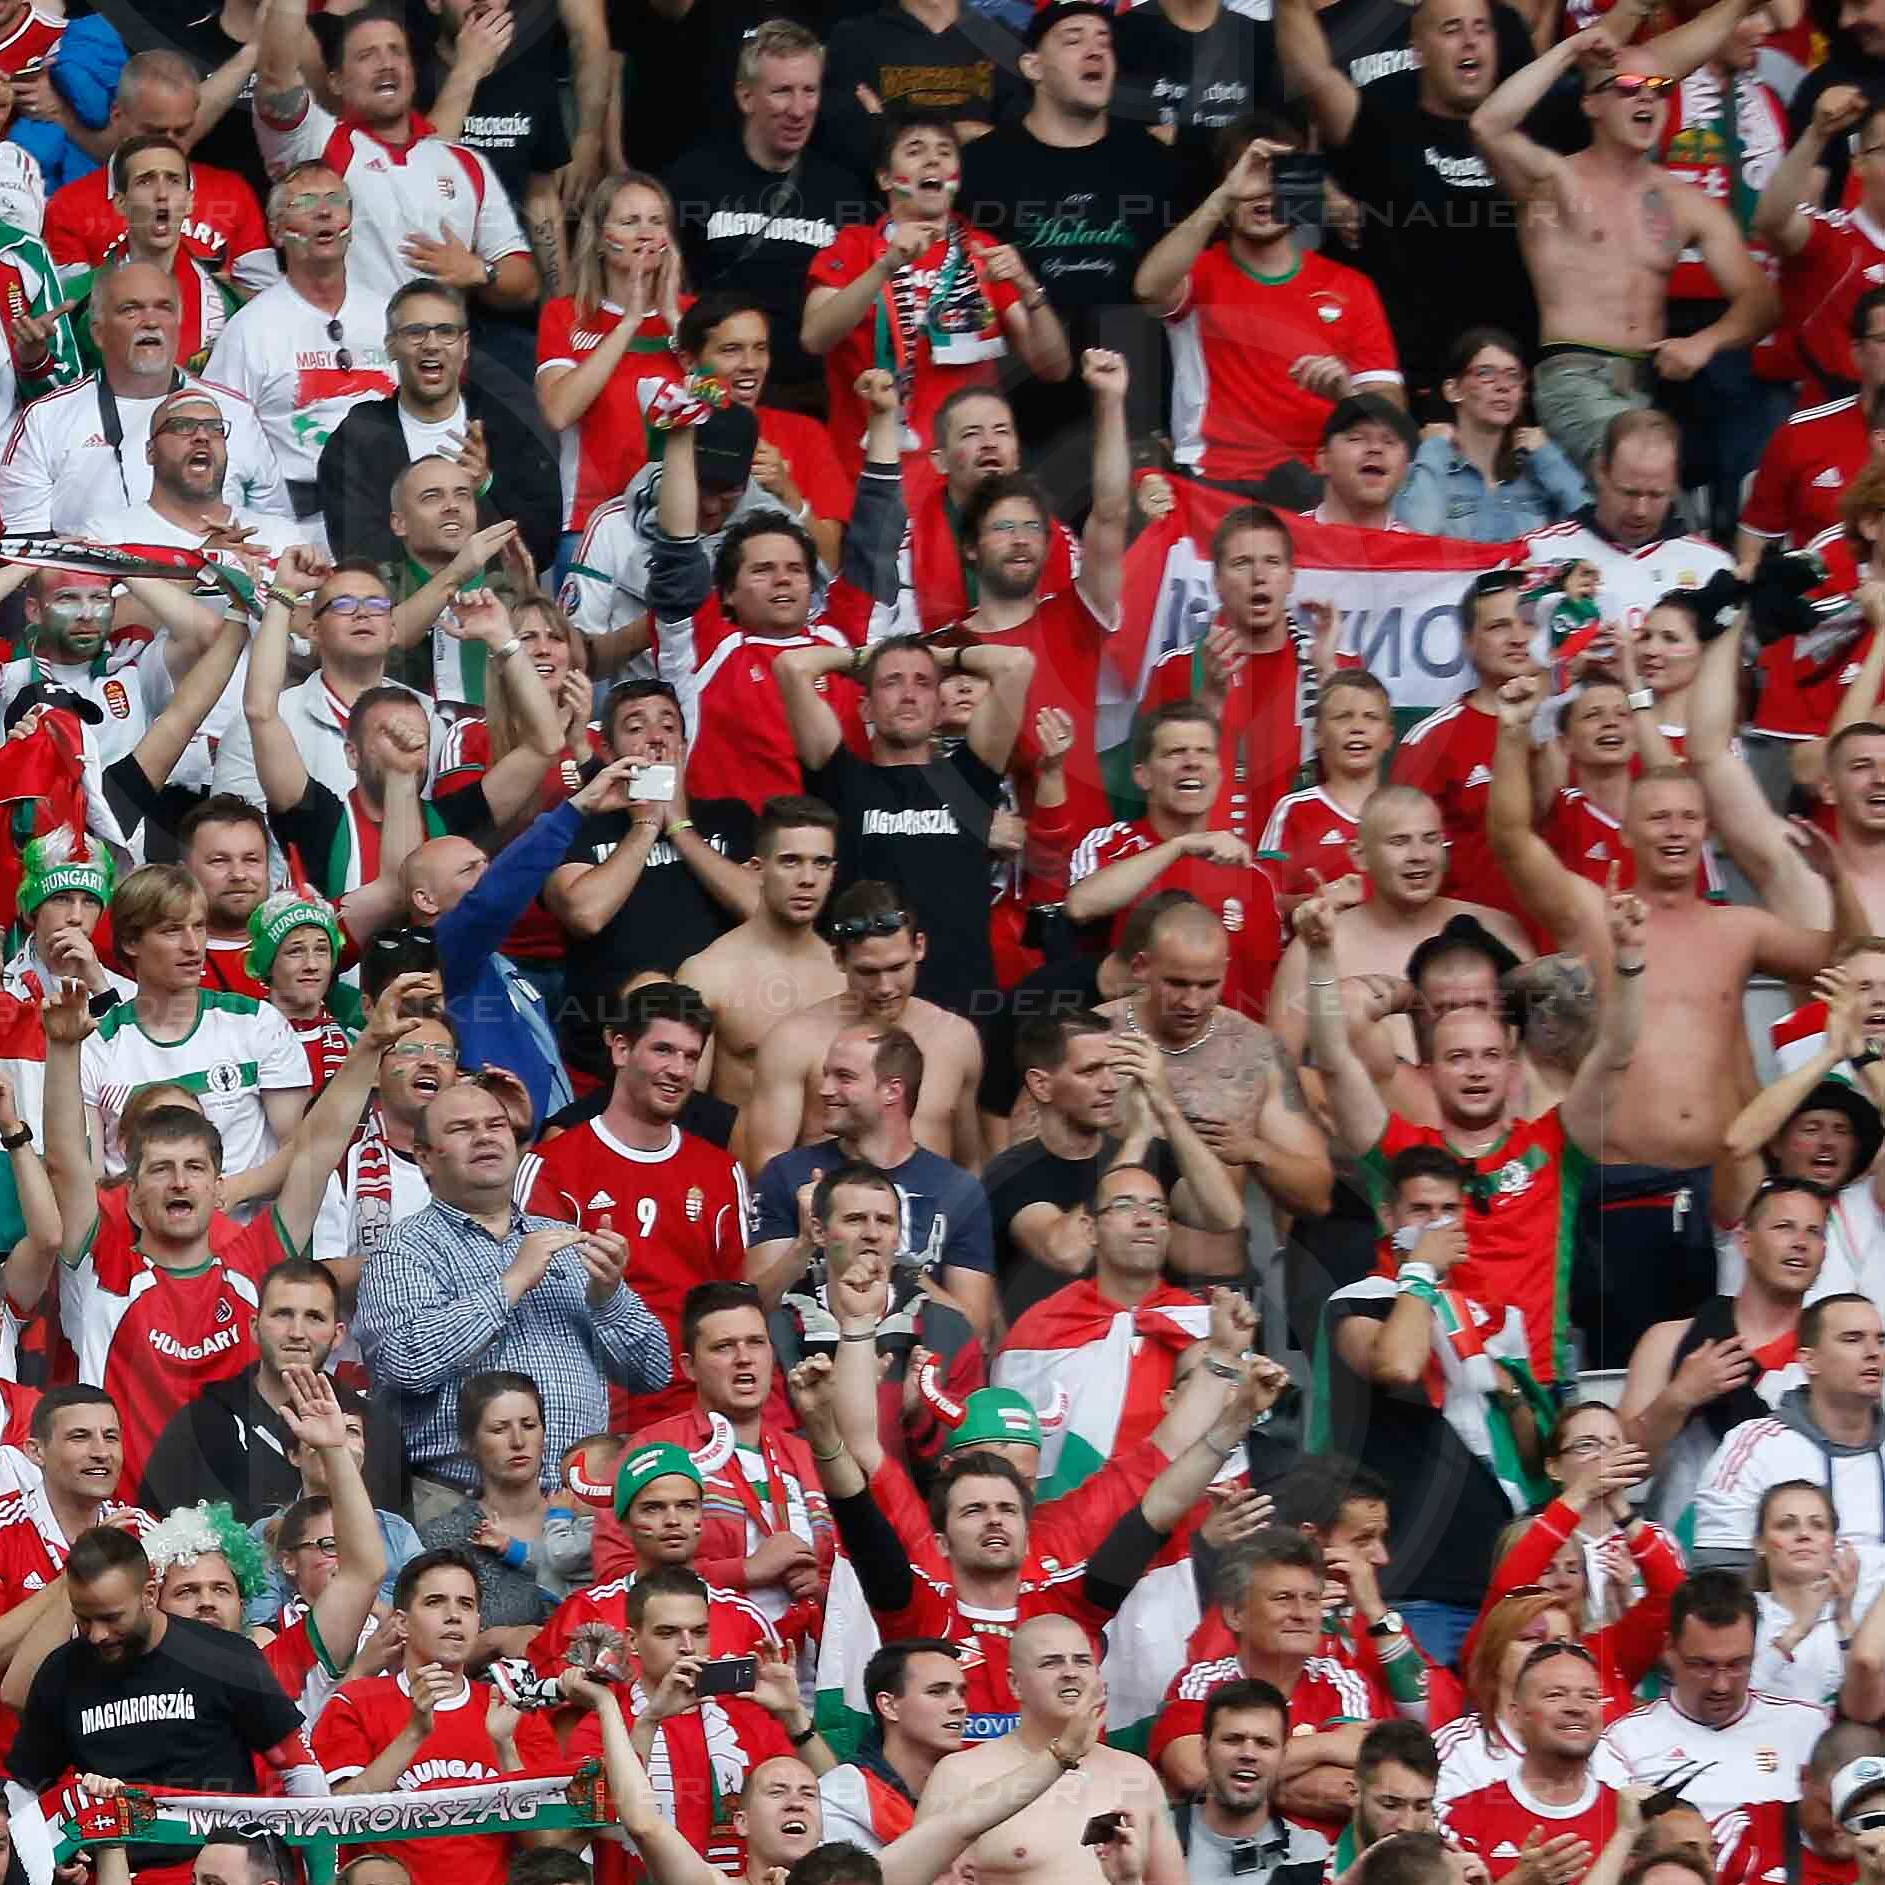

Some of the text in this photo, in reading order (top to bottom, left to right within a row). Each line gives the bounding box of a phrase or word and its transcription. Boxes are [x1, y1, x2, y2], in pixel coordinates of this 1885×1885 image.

[39, 863, 104, 895] HUNGARY
[266, 904, 330, 941] HUNGARY
[636, 1196, 658, 1239] 9
[147, 1322, 241, 1359] HUNGARY
[81, 1690, 196, 1736] MAGYARORSZÁG
[396, 1759, 499, 1791] HUNGA
